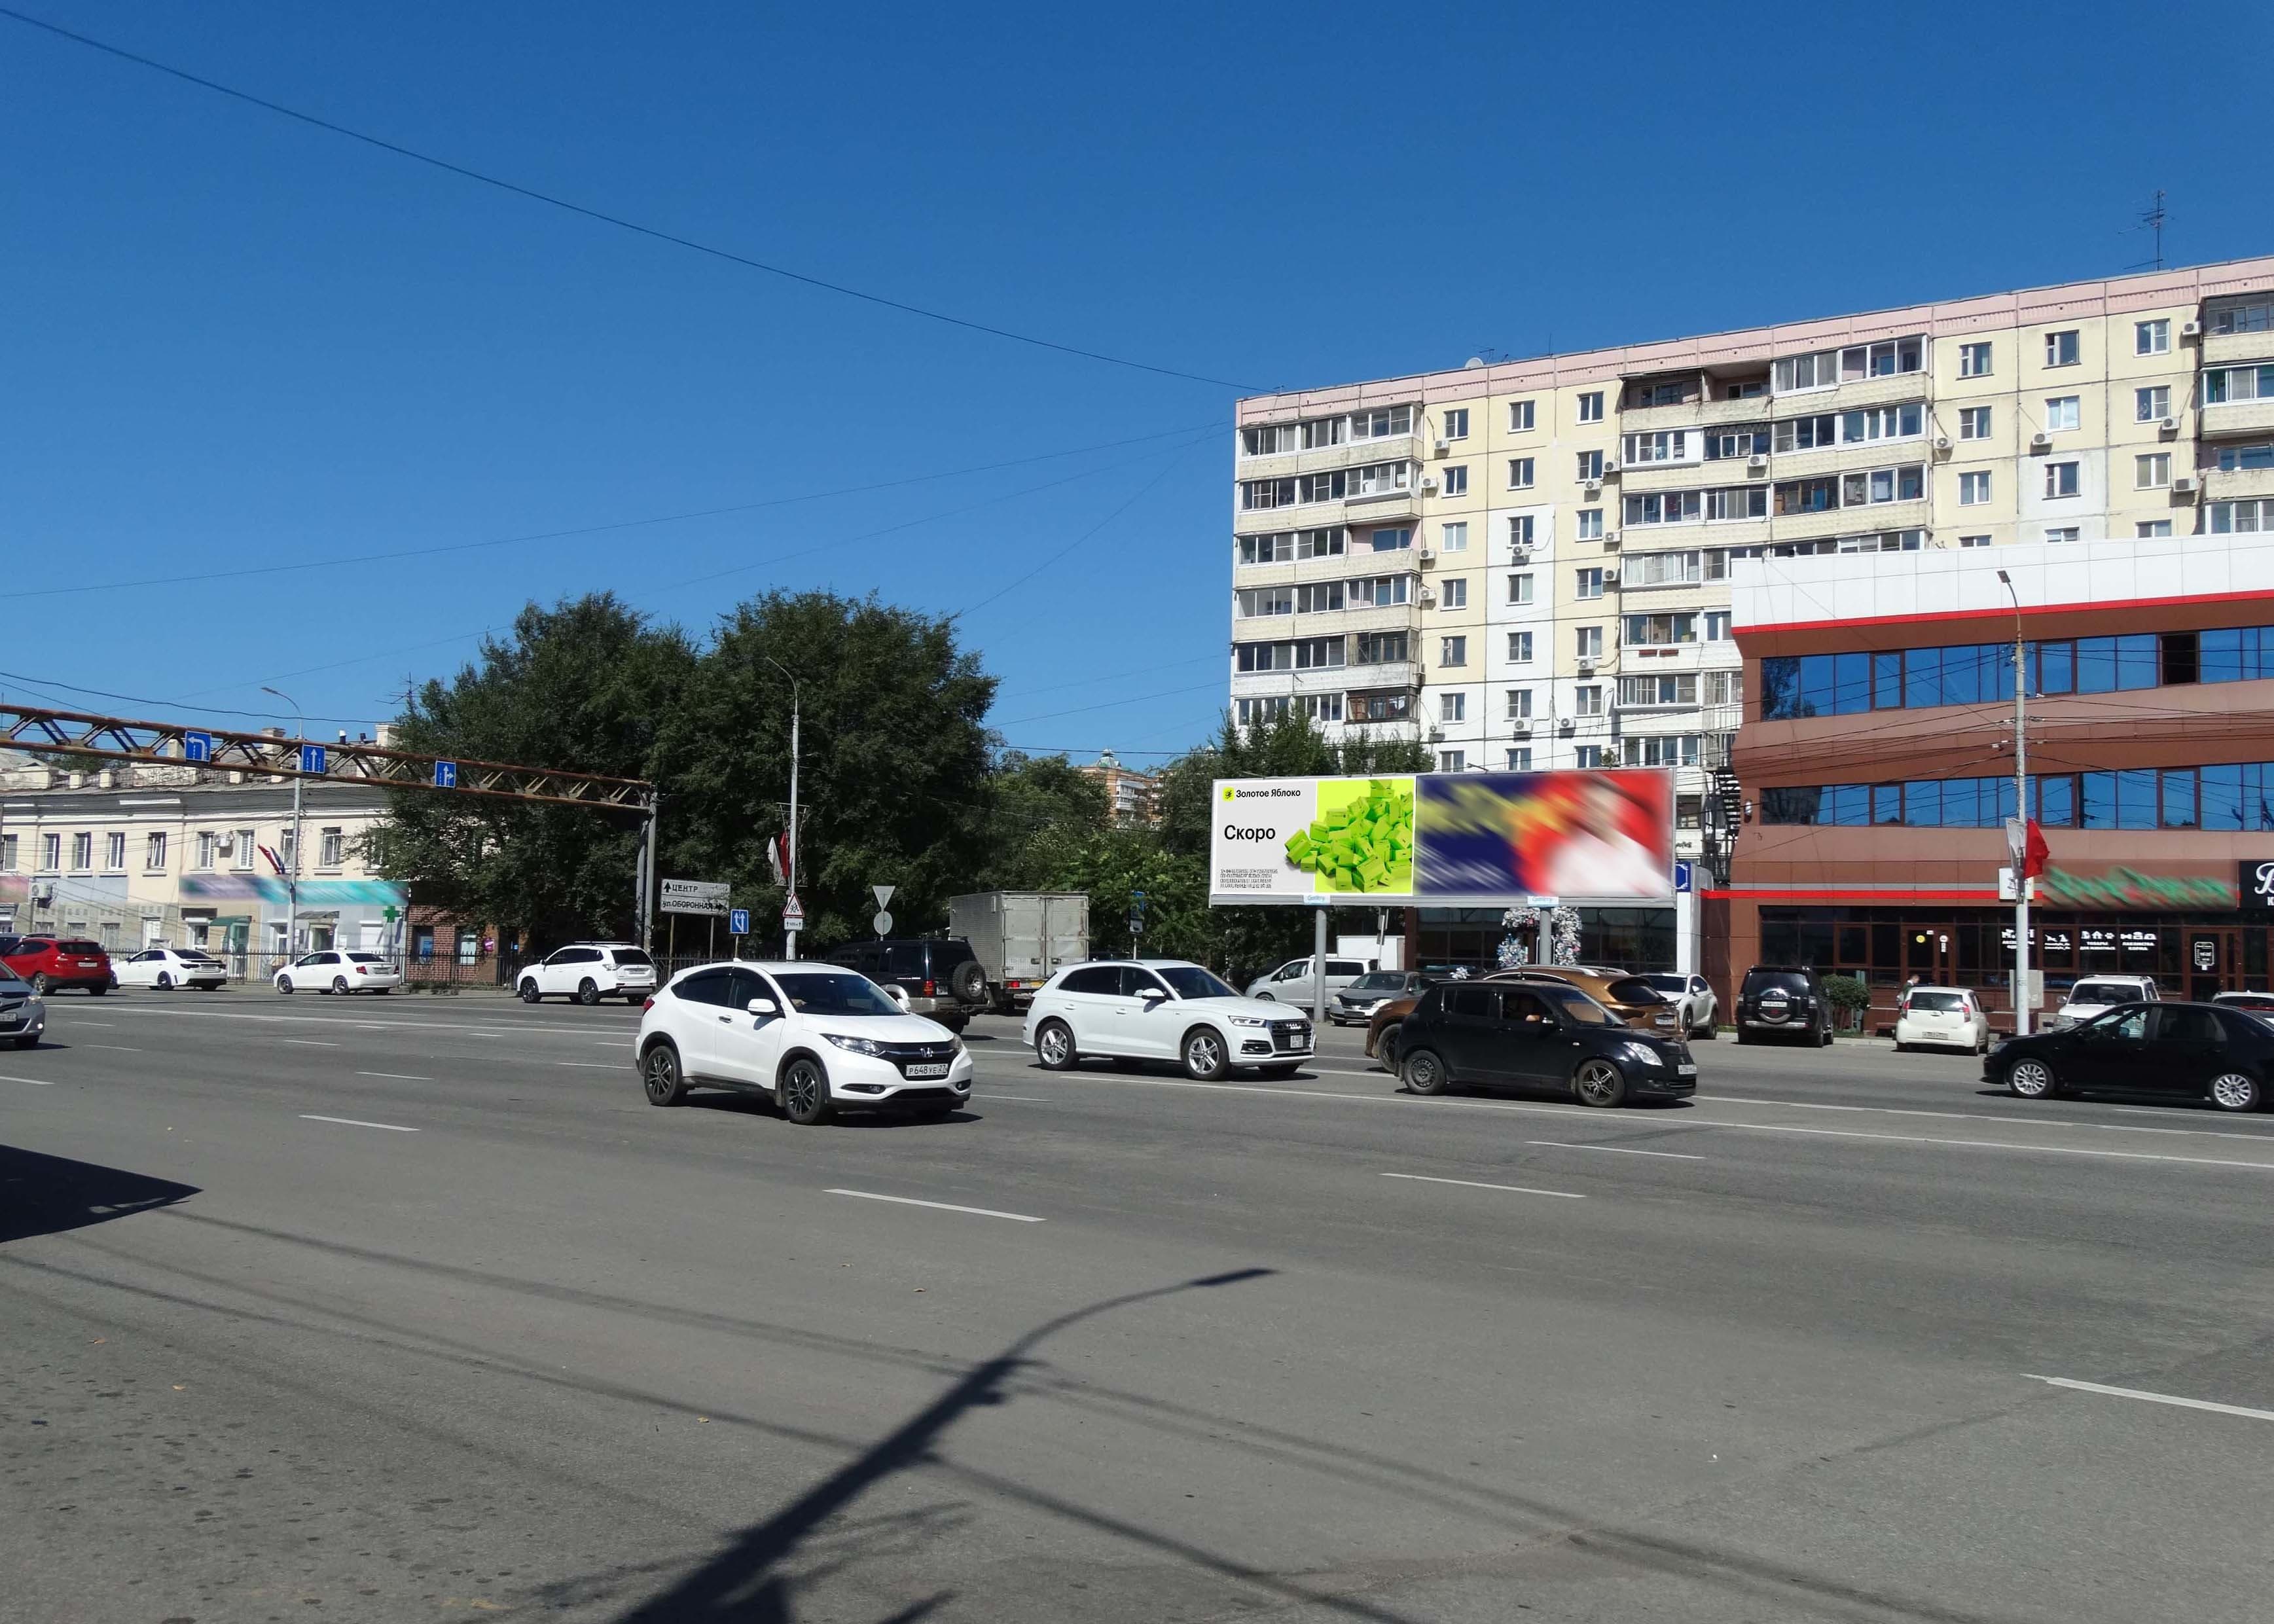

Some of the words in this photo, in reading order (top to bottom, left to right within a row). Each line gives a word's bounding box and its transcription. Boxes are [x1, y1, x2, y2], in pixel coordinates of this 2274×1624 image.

[1236, 789, 1269, 798] Золотое
[1271, 788, 1301, 797] Яблоко
[1224, 825, 1276, 843] Скоро
